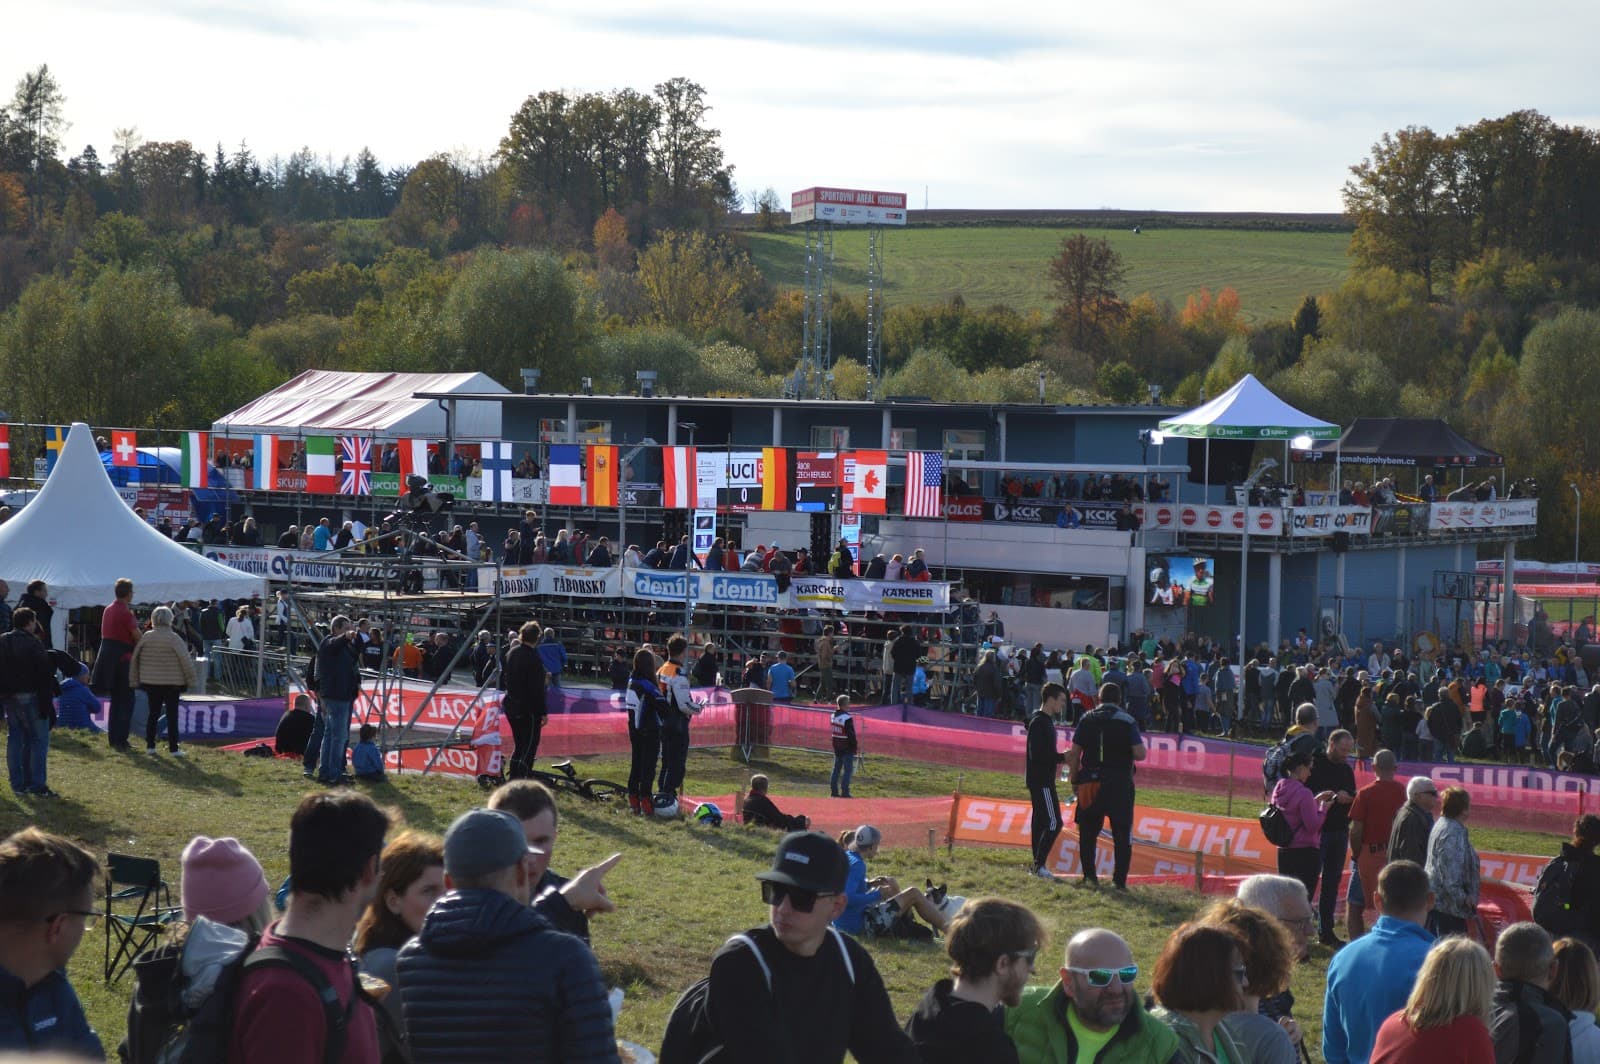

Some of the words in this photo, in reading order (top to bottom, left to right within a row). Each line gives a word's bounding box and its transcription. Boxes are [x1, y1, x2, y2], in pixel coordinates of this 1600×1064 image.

[731, 463, 755, 479] UCI
[796, 461, 811, 470] ÁBOR
[1012, 507, 1041, 517] KCK
[1085, 509, 1117, 521] KCK
[553, 576, 606, 594] TÁBORSKO
[636, 575, 698, 598] deník
[715, 579, 776, 601] deník
[796, 584, 845, 596] KÄRCHER
[882, 587, 933, 598] KÄRCHER
[1431, 766, 1600, 803] SHIMA
[1137, 817, 1262, 859] STIHL
